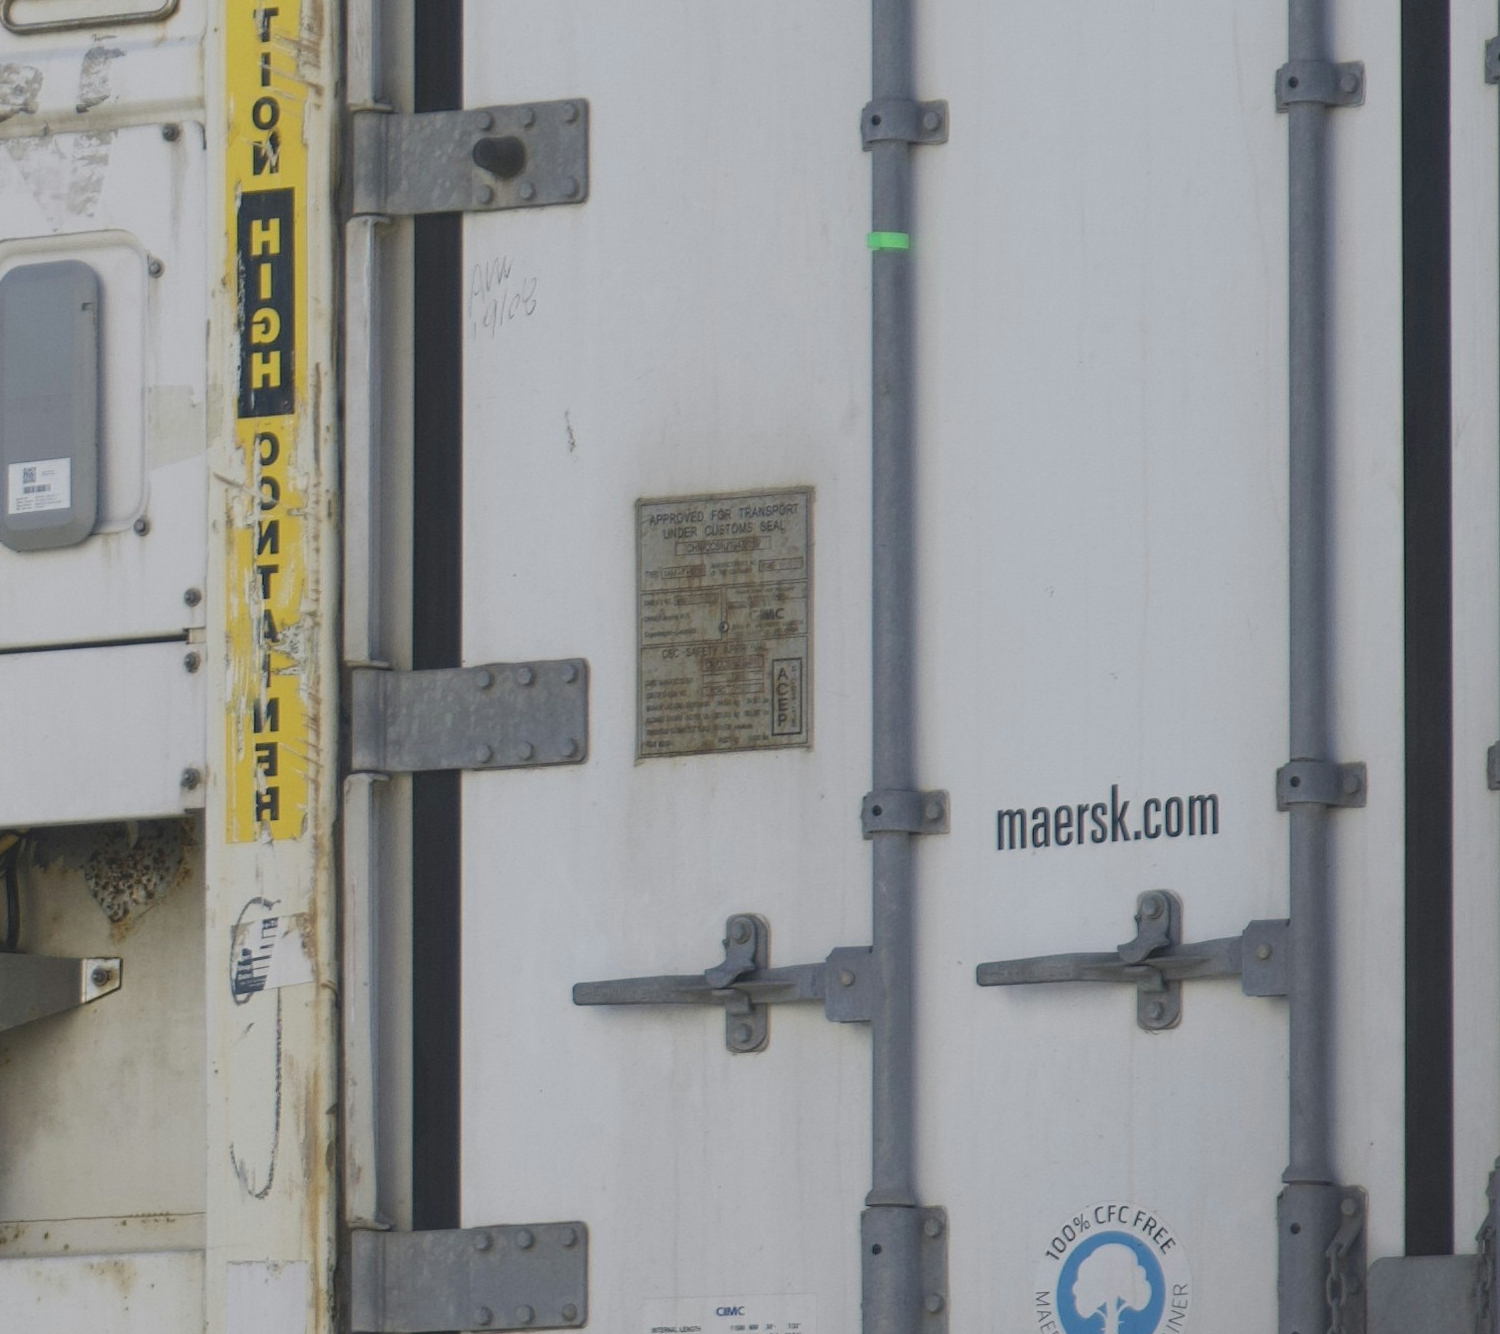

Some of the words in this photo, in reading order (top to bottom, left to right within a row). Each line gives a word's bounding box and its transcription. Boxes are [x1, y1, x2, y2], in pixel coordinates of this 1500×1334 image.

[649, 510, 704, 526] APPROVED
[711, 508, 731, 520] FOR
[738, 503, 799, 519] TRANSPORT
[662, 526, 698, 540] UNDER
[704, 522, 753, 537] CUSTOMS
[760, 519, 786, 533] SEAL
[997, 788, 1220, 852] maersk.com
[1045, 1213, 1091, 1261] 100%
[1094, 1205, 1130, 1224] CFC
[1133, 1210, 1176, 1255] FREE
[716, 1306, 745, 1317] CIMC
